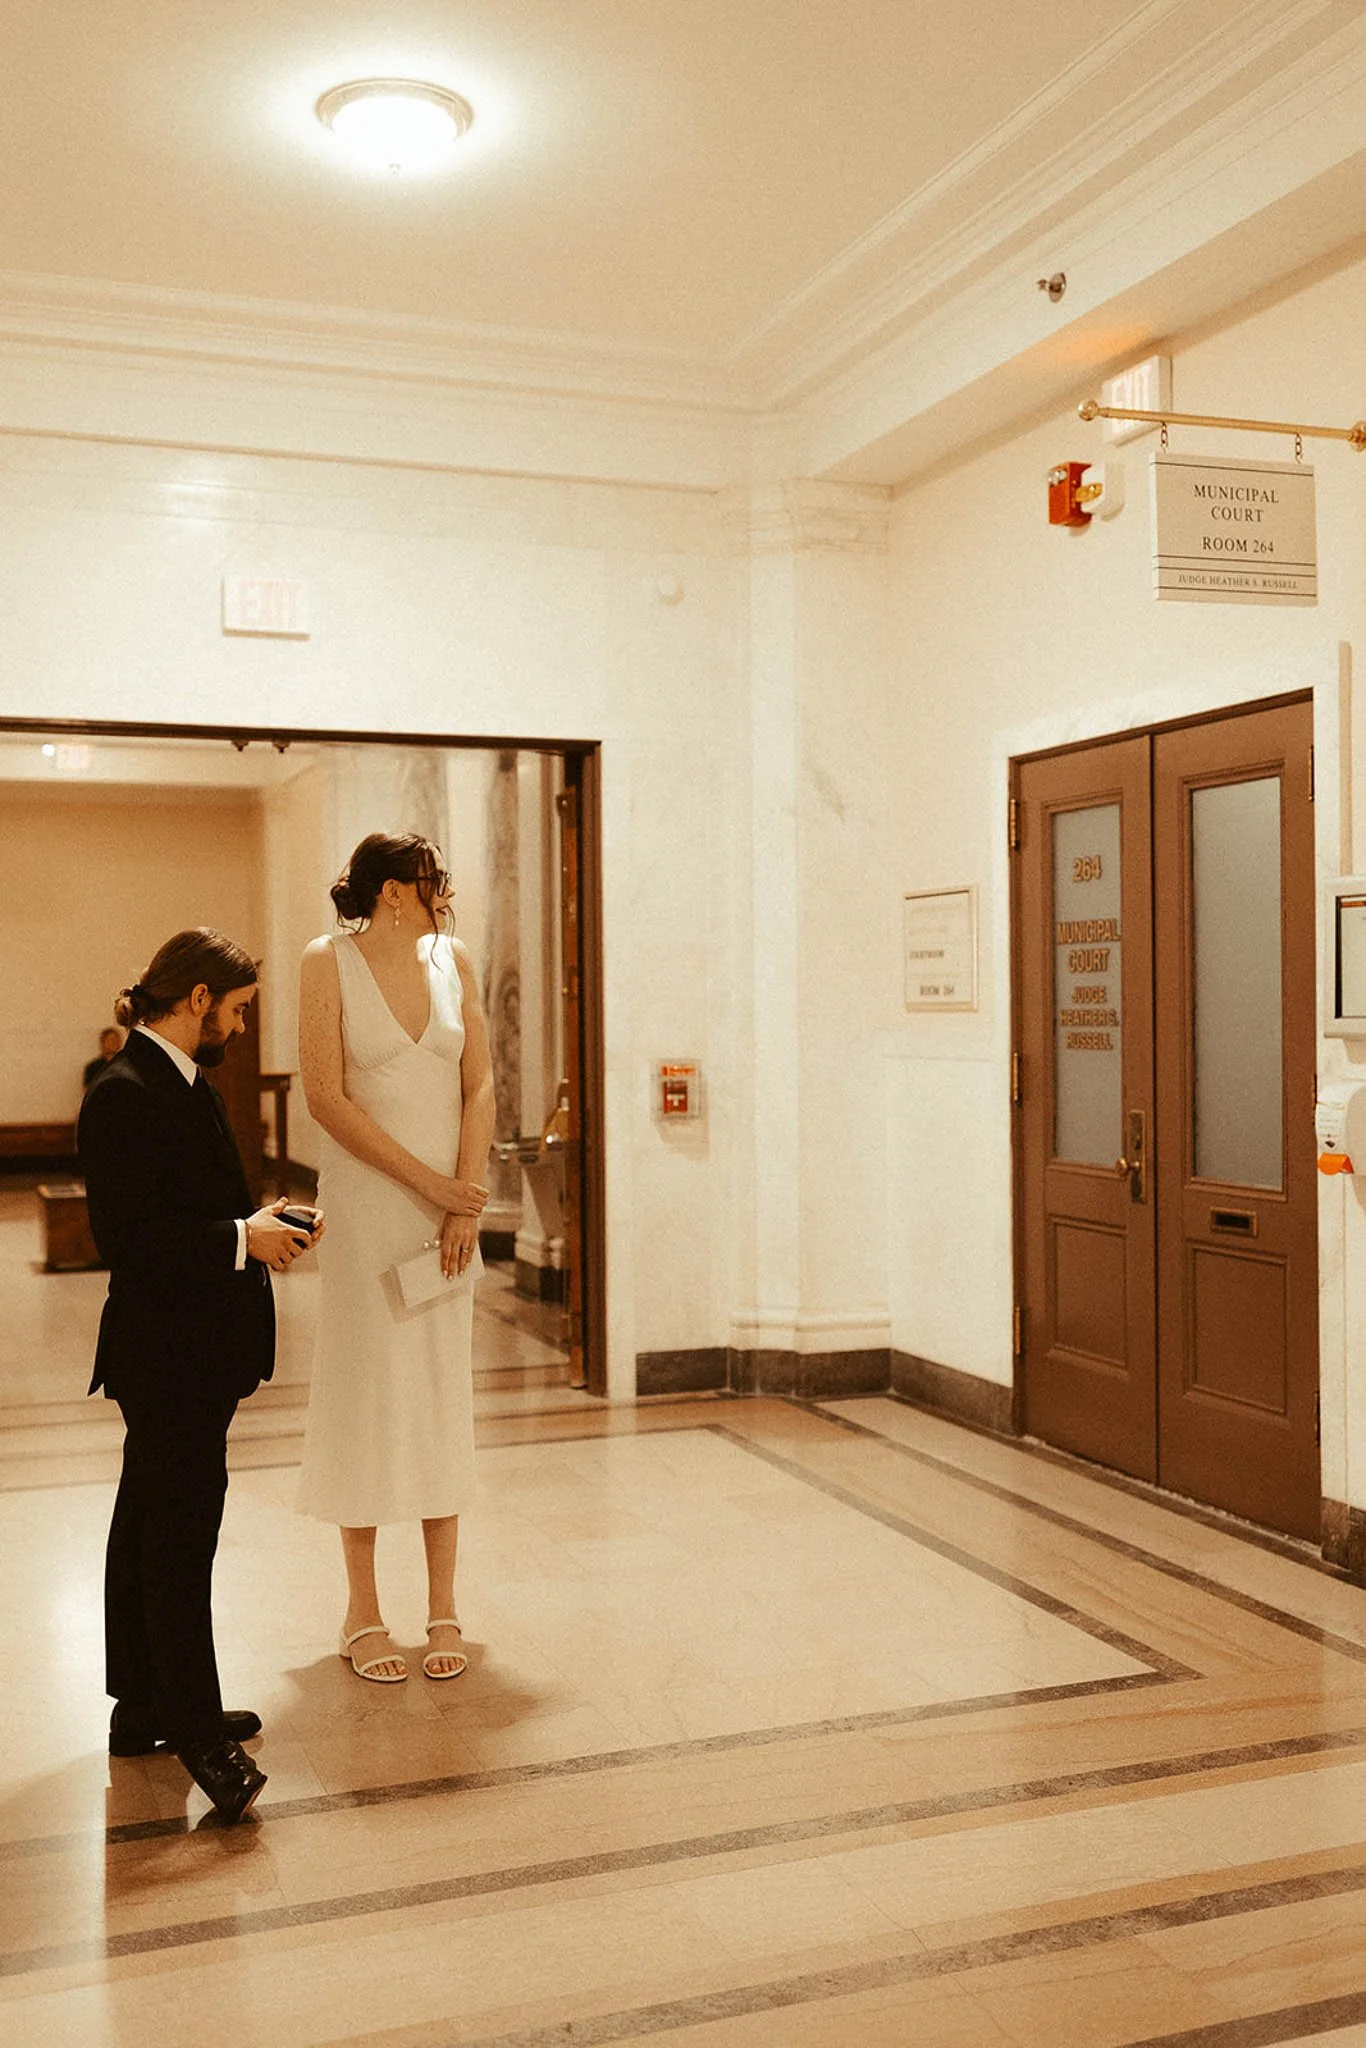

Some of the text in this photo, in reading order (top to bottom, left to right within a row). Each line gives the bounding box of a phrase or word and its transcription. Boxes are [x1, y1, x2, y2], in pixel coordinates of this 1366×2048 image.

[1193, 484, 1280, 504] MUNICIPAL
[1211, 506, 1264, 523] COURT
[1202, 536, 1275, 554] ROOM 264
[1178, 574, 1207, 585] JUDGE
[1209, 575, 1249, 587] HEATHER
[1262, 578, 1298, 589] RUSSELL
[1072, 855, 1102, 882] 264
[1057, 919, 1121, 944] MUNICIPAL
[1068, 948, 1110, 973] COURT
